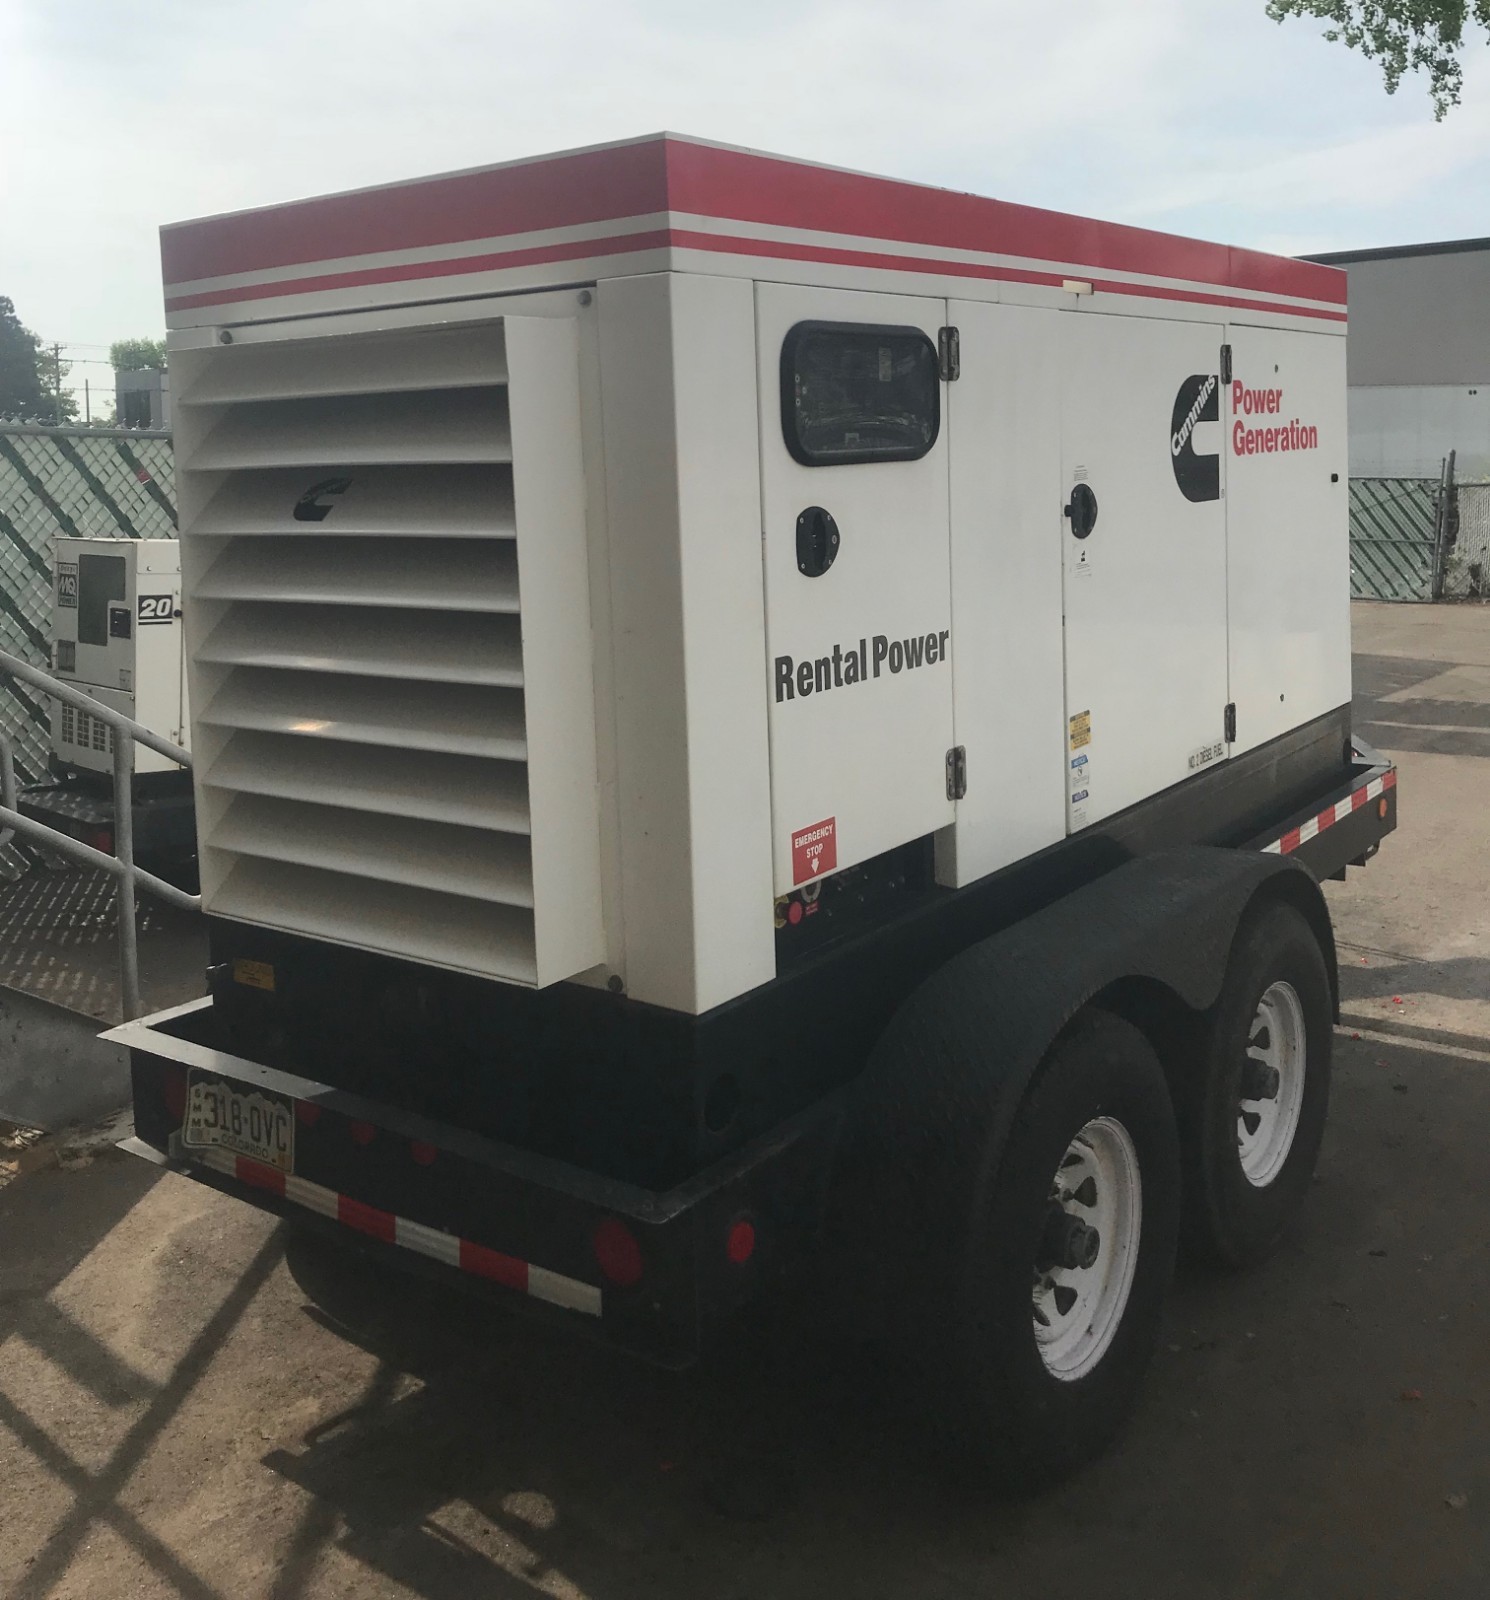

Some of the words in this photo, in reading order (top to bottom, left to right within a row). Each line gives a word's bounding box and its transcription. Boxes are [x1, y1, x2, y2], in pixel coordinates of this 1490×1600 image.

[1233, 379, 1282, 414] Power
[1171, 374, 1215, 456] Cummins
[1233, 418, 1318, 457] Generation
[139, 598, 172, 618] 20
[774, 638, 868, 704] Rental
[872, 629, 950, 679] Power
[795, 824, 833, 848] EMERGENCY
[806, 843, 824, 858] STOP
[221, 1133, 269, 1159] COLORADO
